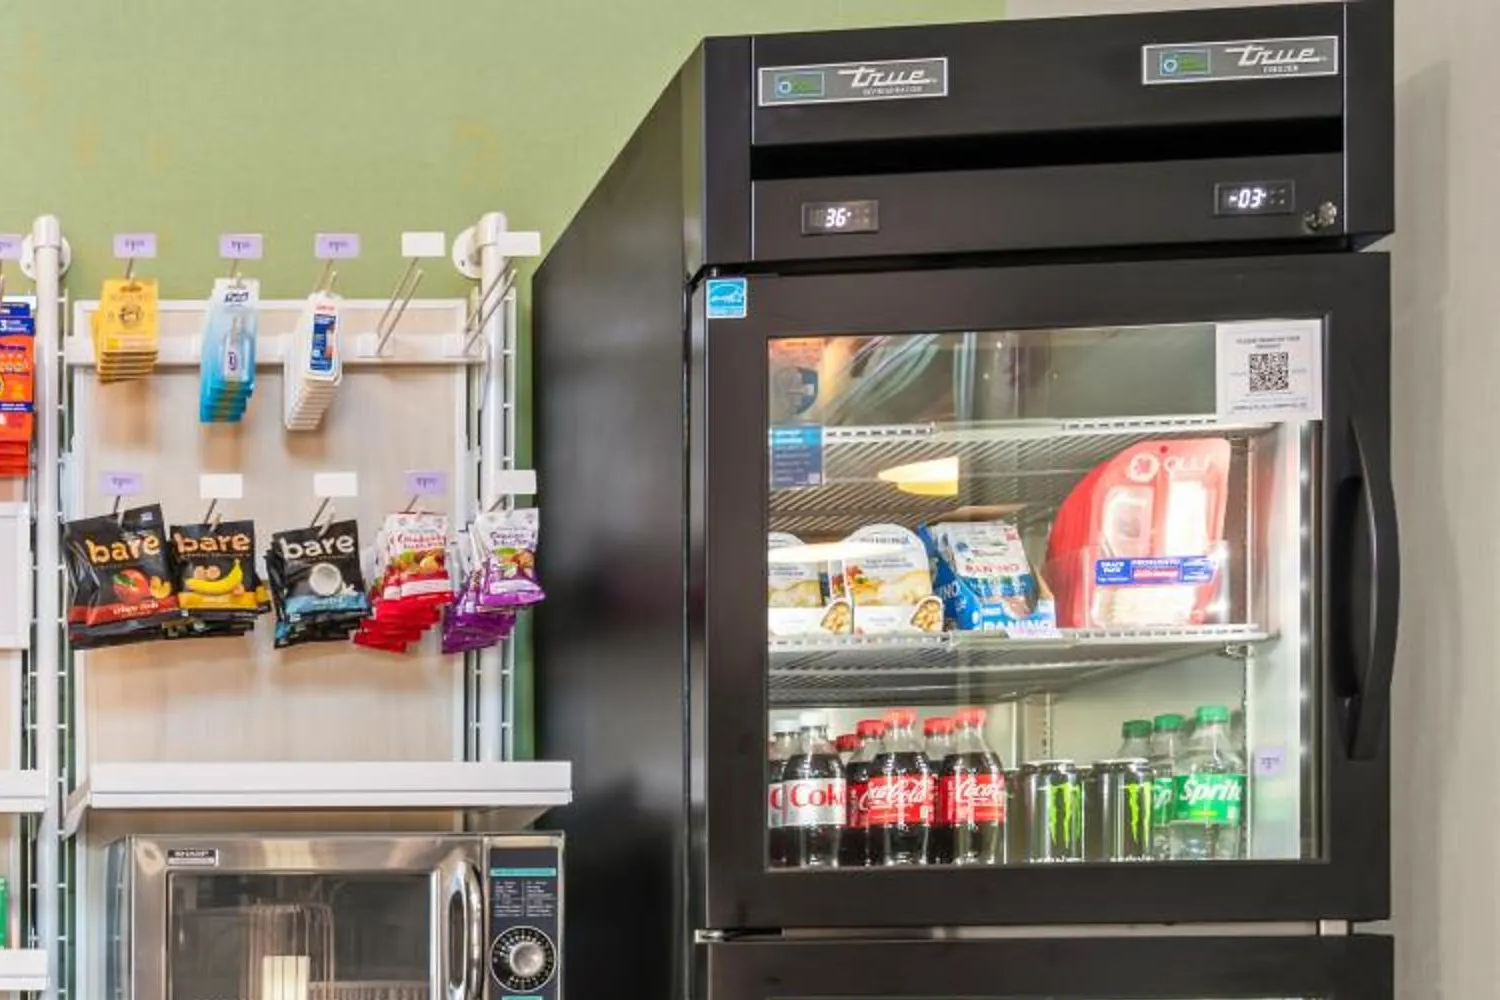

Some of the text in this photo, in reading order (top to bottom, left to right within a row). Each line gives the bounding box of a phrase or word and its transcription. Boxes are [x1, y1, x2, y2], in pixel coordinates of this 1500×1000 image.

[85, 534, 161, 564] bare
[173, 532, 250, 554] bare
[281, 534, 355, 560] bare
